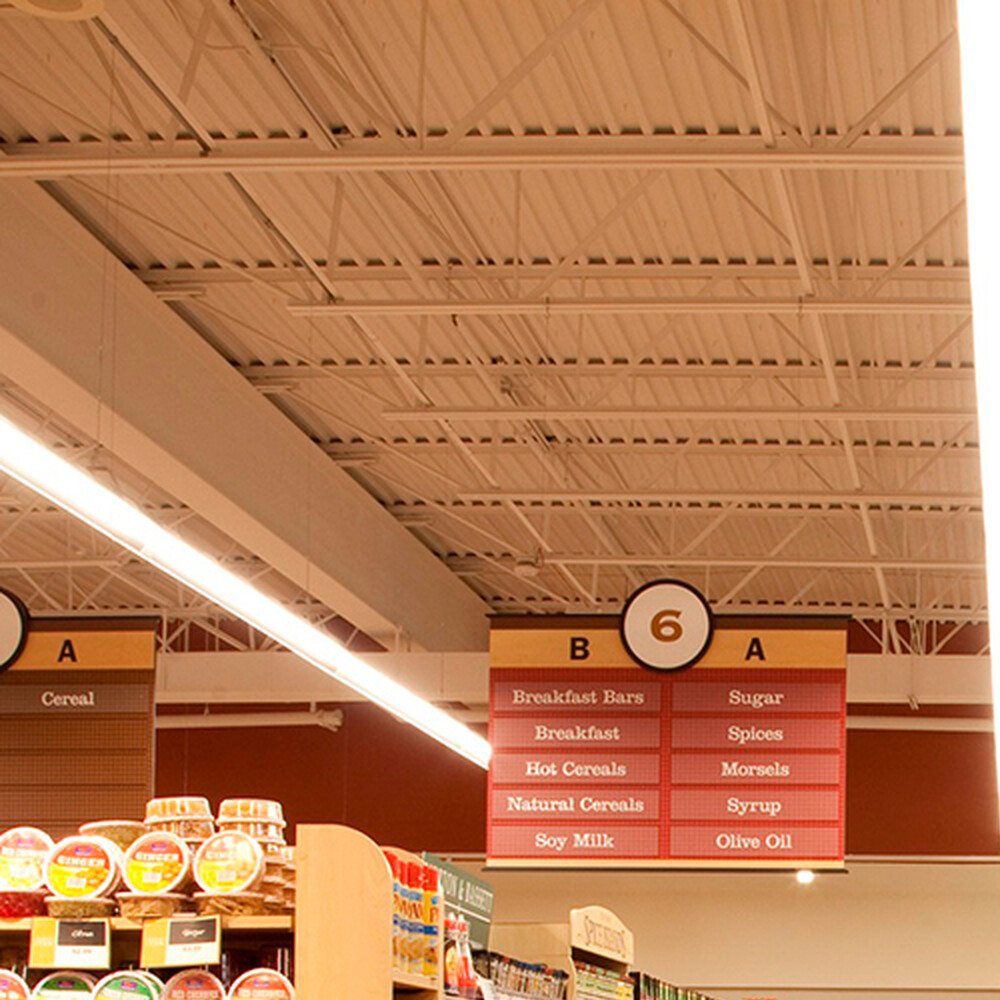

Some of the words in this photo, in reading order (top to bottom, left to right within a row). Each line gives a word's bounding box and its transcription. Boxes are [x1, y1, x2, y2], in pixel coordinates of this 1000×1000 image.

[650, 609, 684, 642] 6
[57, 639, 78, 662] A
[570, 637, 590, 660] B
[744, 637, 766, 661] A
[41, 691, 95, 706] Cereal
[512, 689, 598, 704] Breakfast
[602, 690, 644, 704] Bars
[728, 690, 784, 709] Sugar
[534, 725, 620, 740] Breakfast
[728, 726, 784, 744] Spices
[524, 762, 558, 776] Hot
[562, 762, 626, 776] Cereals
[721, 762, 790, 776] Morsels
[507, 797, 574, 812] Natural
[580, 797, 644, 812] Cereals
[727, 798, 781, 816] Syrup
[535, 834, 567, 850] Soy
[573, 833, 614, 848] Milk
[716, 834, 760, 849] Olive
[765, 834, 792, 849] Oil
